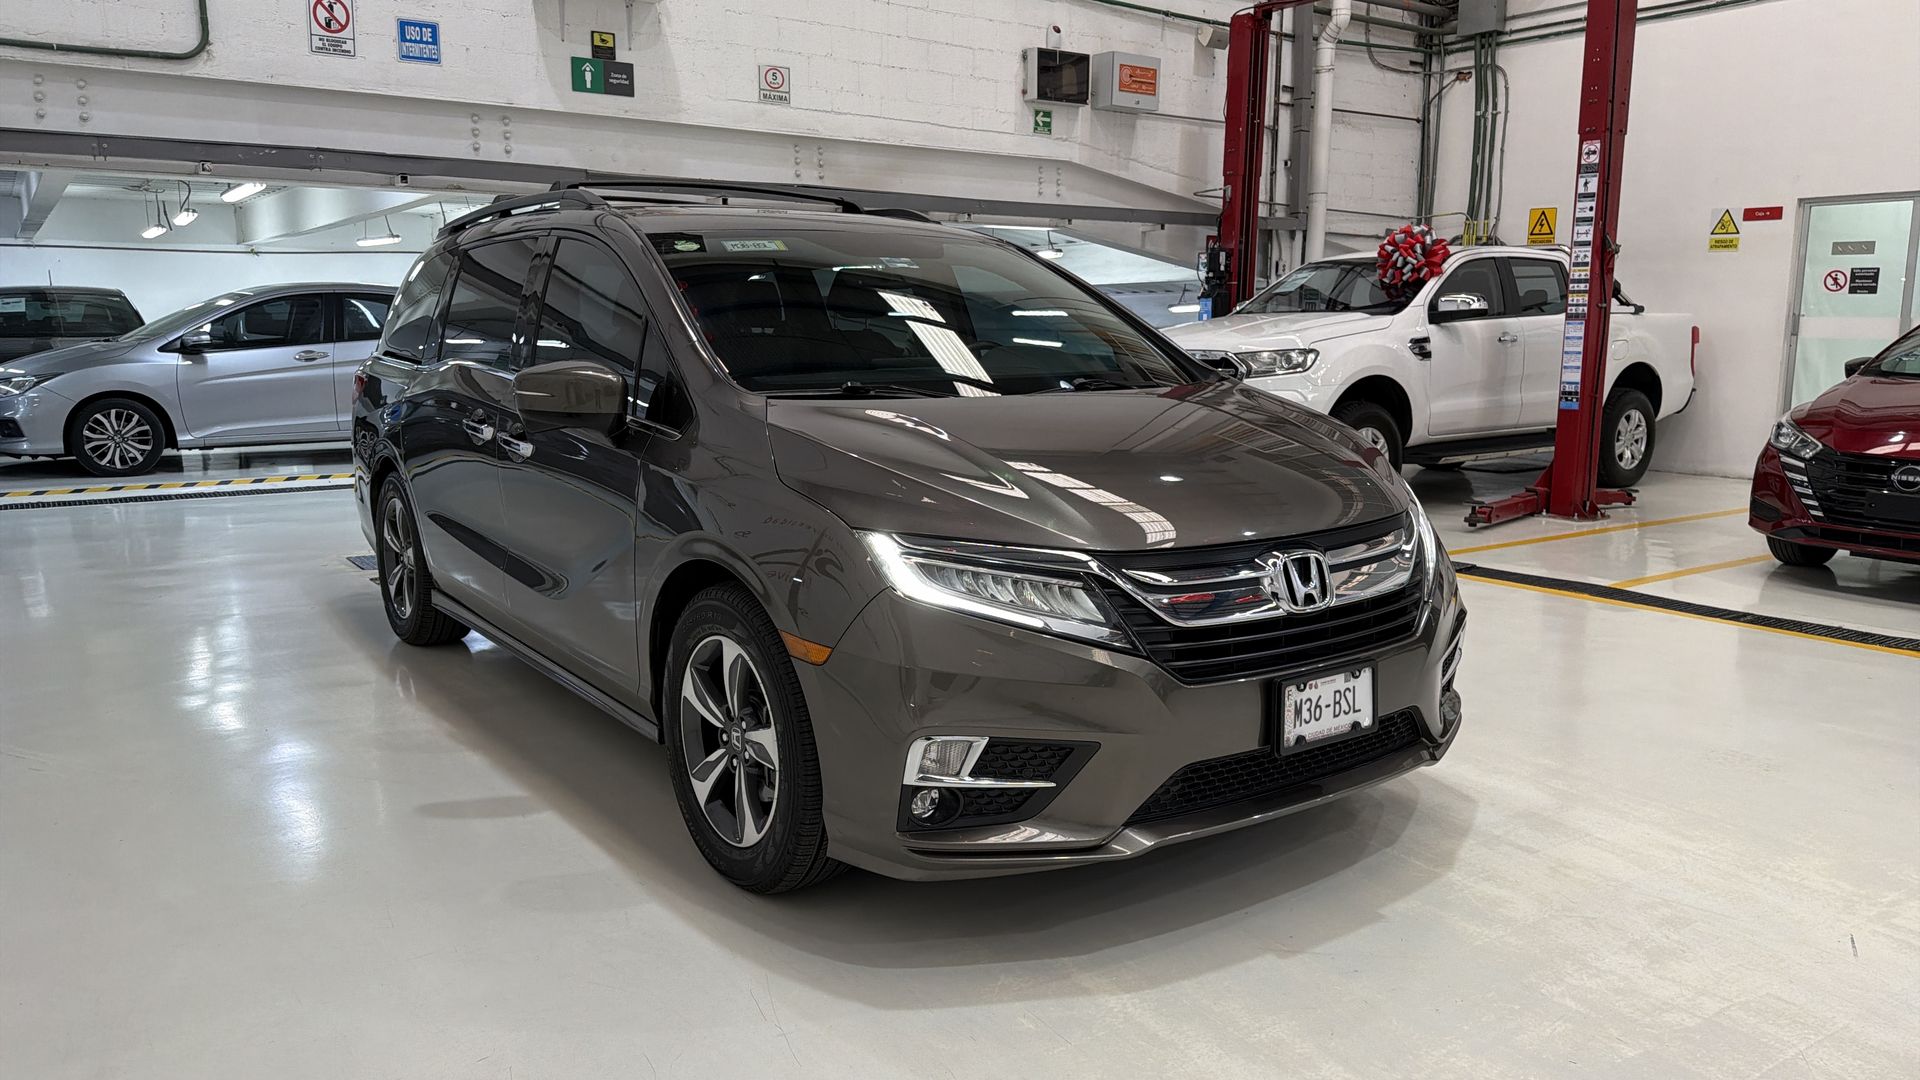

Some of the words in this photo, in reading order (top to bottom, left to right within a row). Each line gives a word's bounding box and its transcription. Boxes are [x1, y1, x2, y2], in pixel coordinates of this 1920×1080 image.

[405, 25, 420, 40] USO
[421, 27, 432, 42] DE
[401, 42, 438, 59] INTERMITENTES
[771, 72, 778, 81] 5
[1293, 686, 1362, 729] M36-BSL
